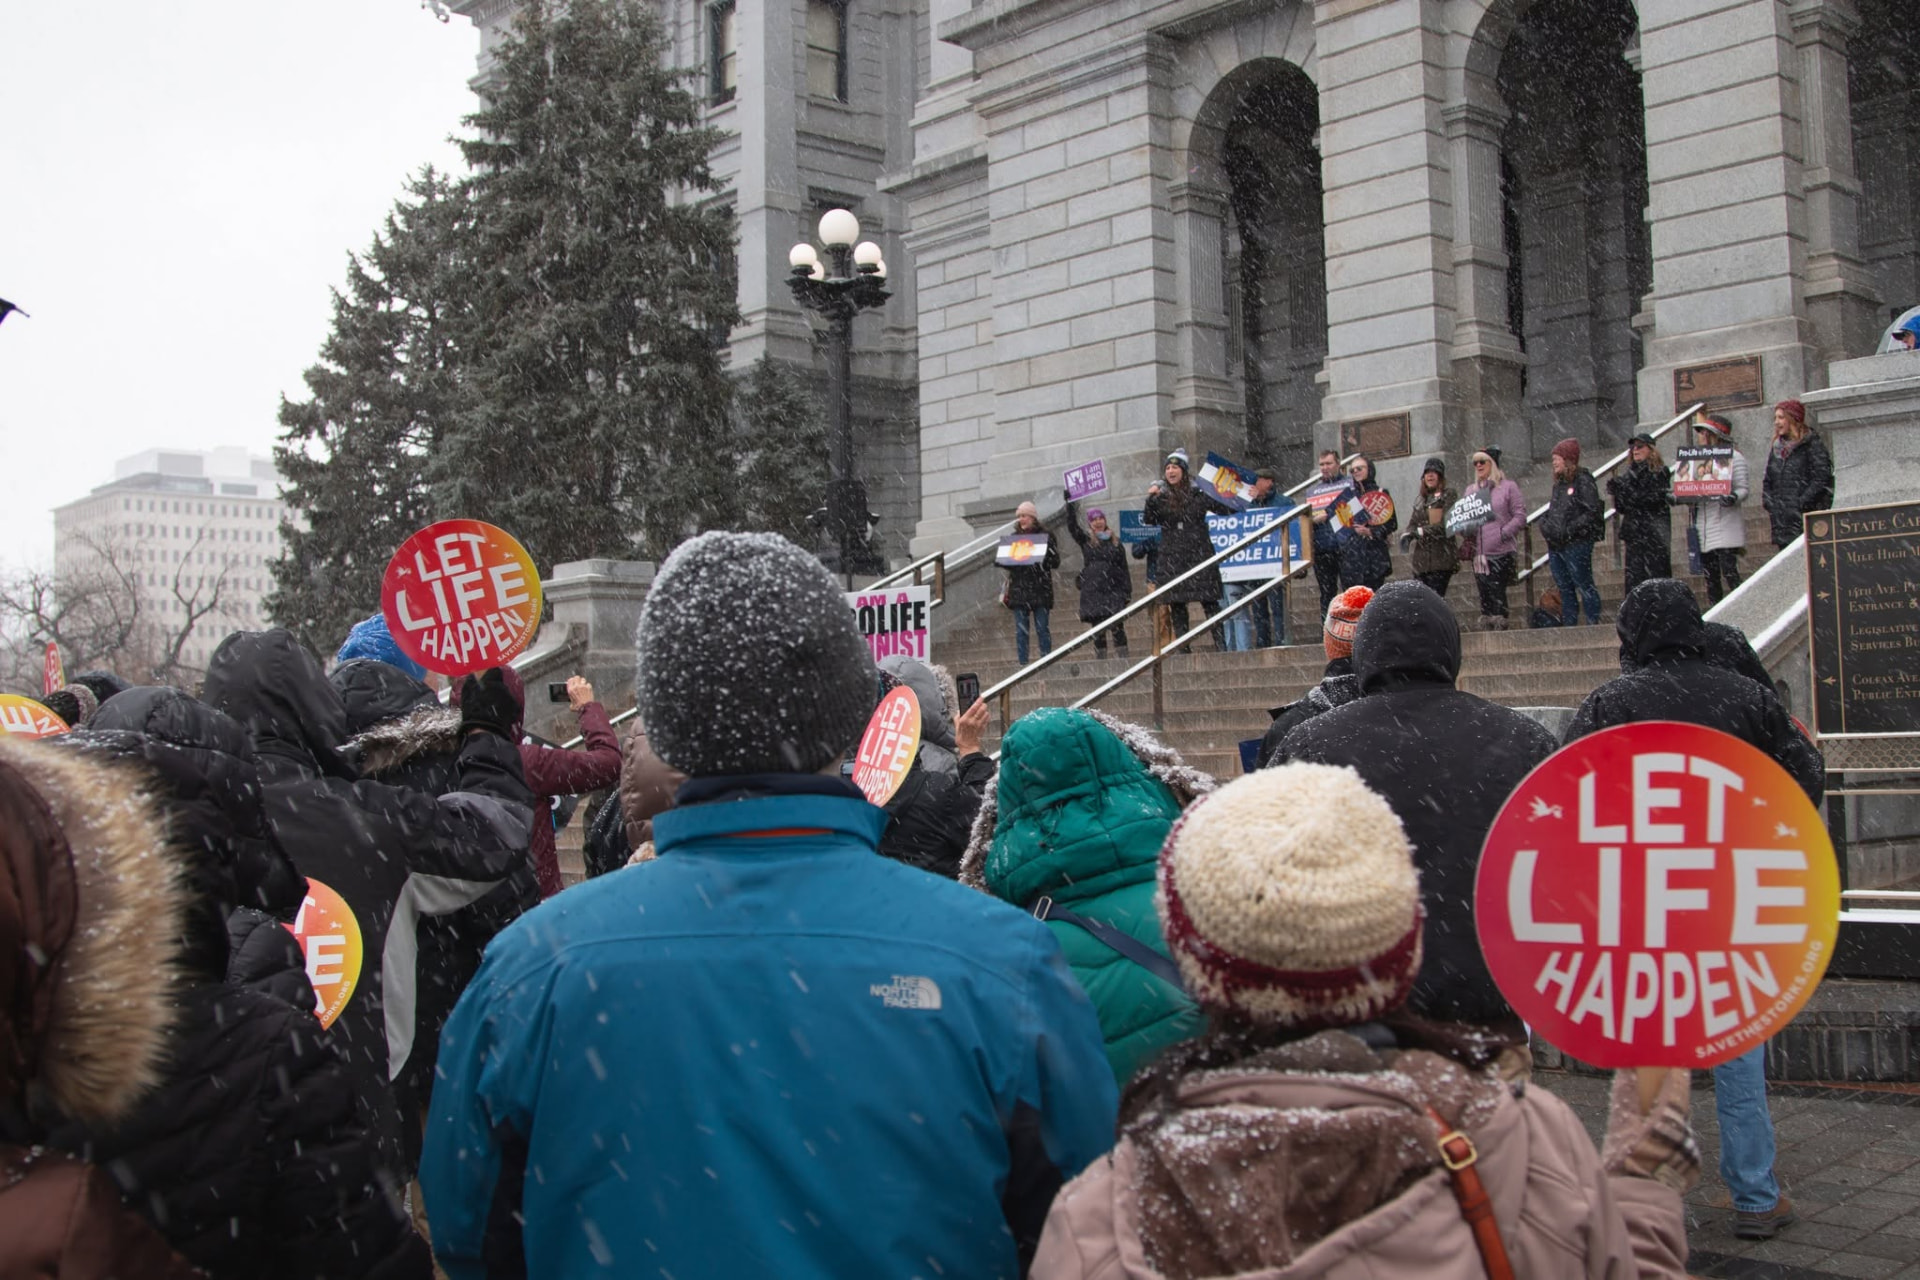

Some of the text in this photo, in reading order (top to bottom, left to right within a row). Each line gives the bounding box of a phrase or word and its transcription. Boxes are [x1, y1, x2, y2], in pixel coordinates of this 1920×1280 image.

[1086, 471, 1102, 482] PRO
[1087, 479, 1104, 490] LIFE
[1445, 503, 1492, 529] ABORTION
[1450, 507, 1462, 517] TO
[1463, 498, 1483, 512] END
[1208, 513, 1274, 531] PRO-LIFE
[1210, 533, 1238, 547] FOR
[414, 533, 487, 582] LET
[395, 562, 530, 632] LIFE
[856, 592, 909, 608] AM A
[420, 608, 525, 664] HAPPEN
[880, 696, 912, 732] LET
[860, 727, 914, 773] LIFE
[856, 765, 894, 803] HAPPEN
[1578, 752, 1744, 843] LET
[1507, 847, 1809, 948] LIFE
[869, 984, 918, 997] NORTH
[891, 975, 919, 986] THE
[883, 996, 919, 1008] FACE
[1534, 950, 1780, 1047] HAPPEN
[1695, 940, 1823, 1058] SAVETHESTORKS.ORG
